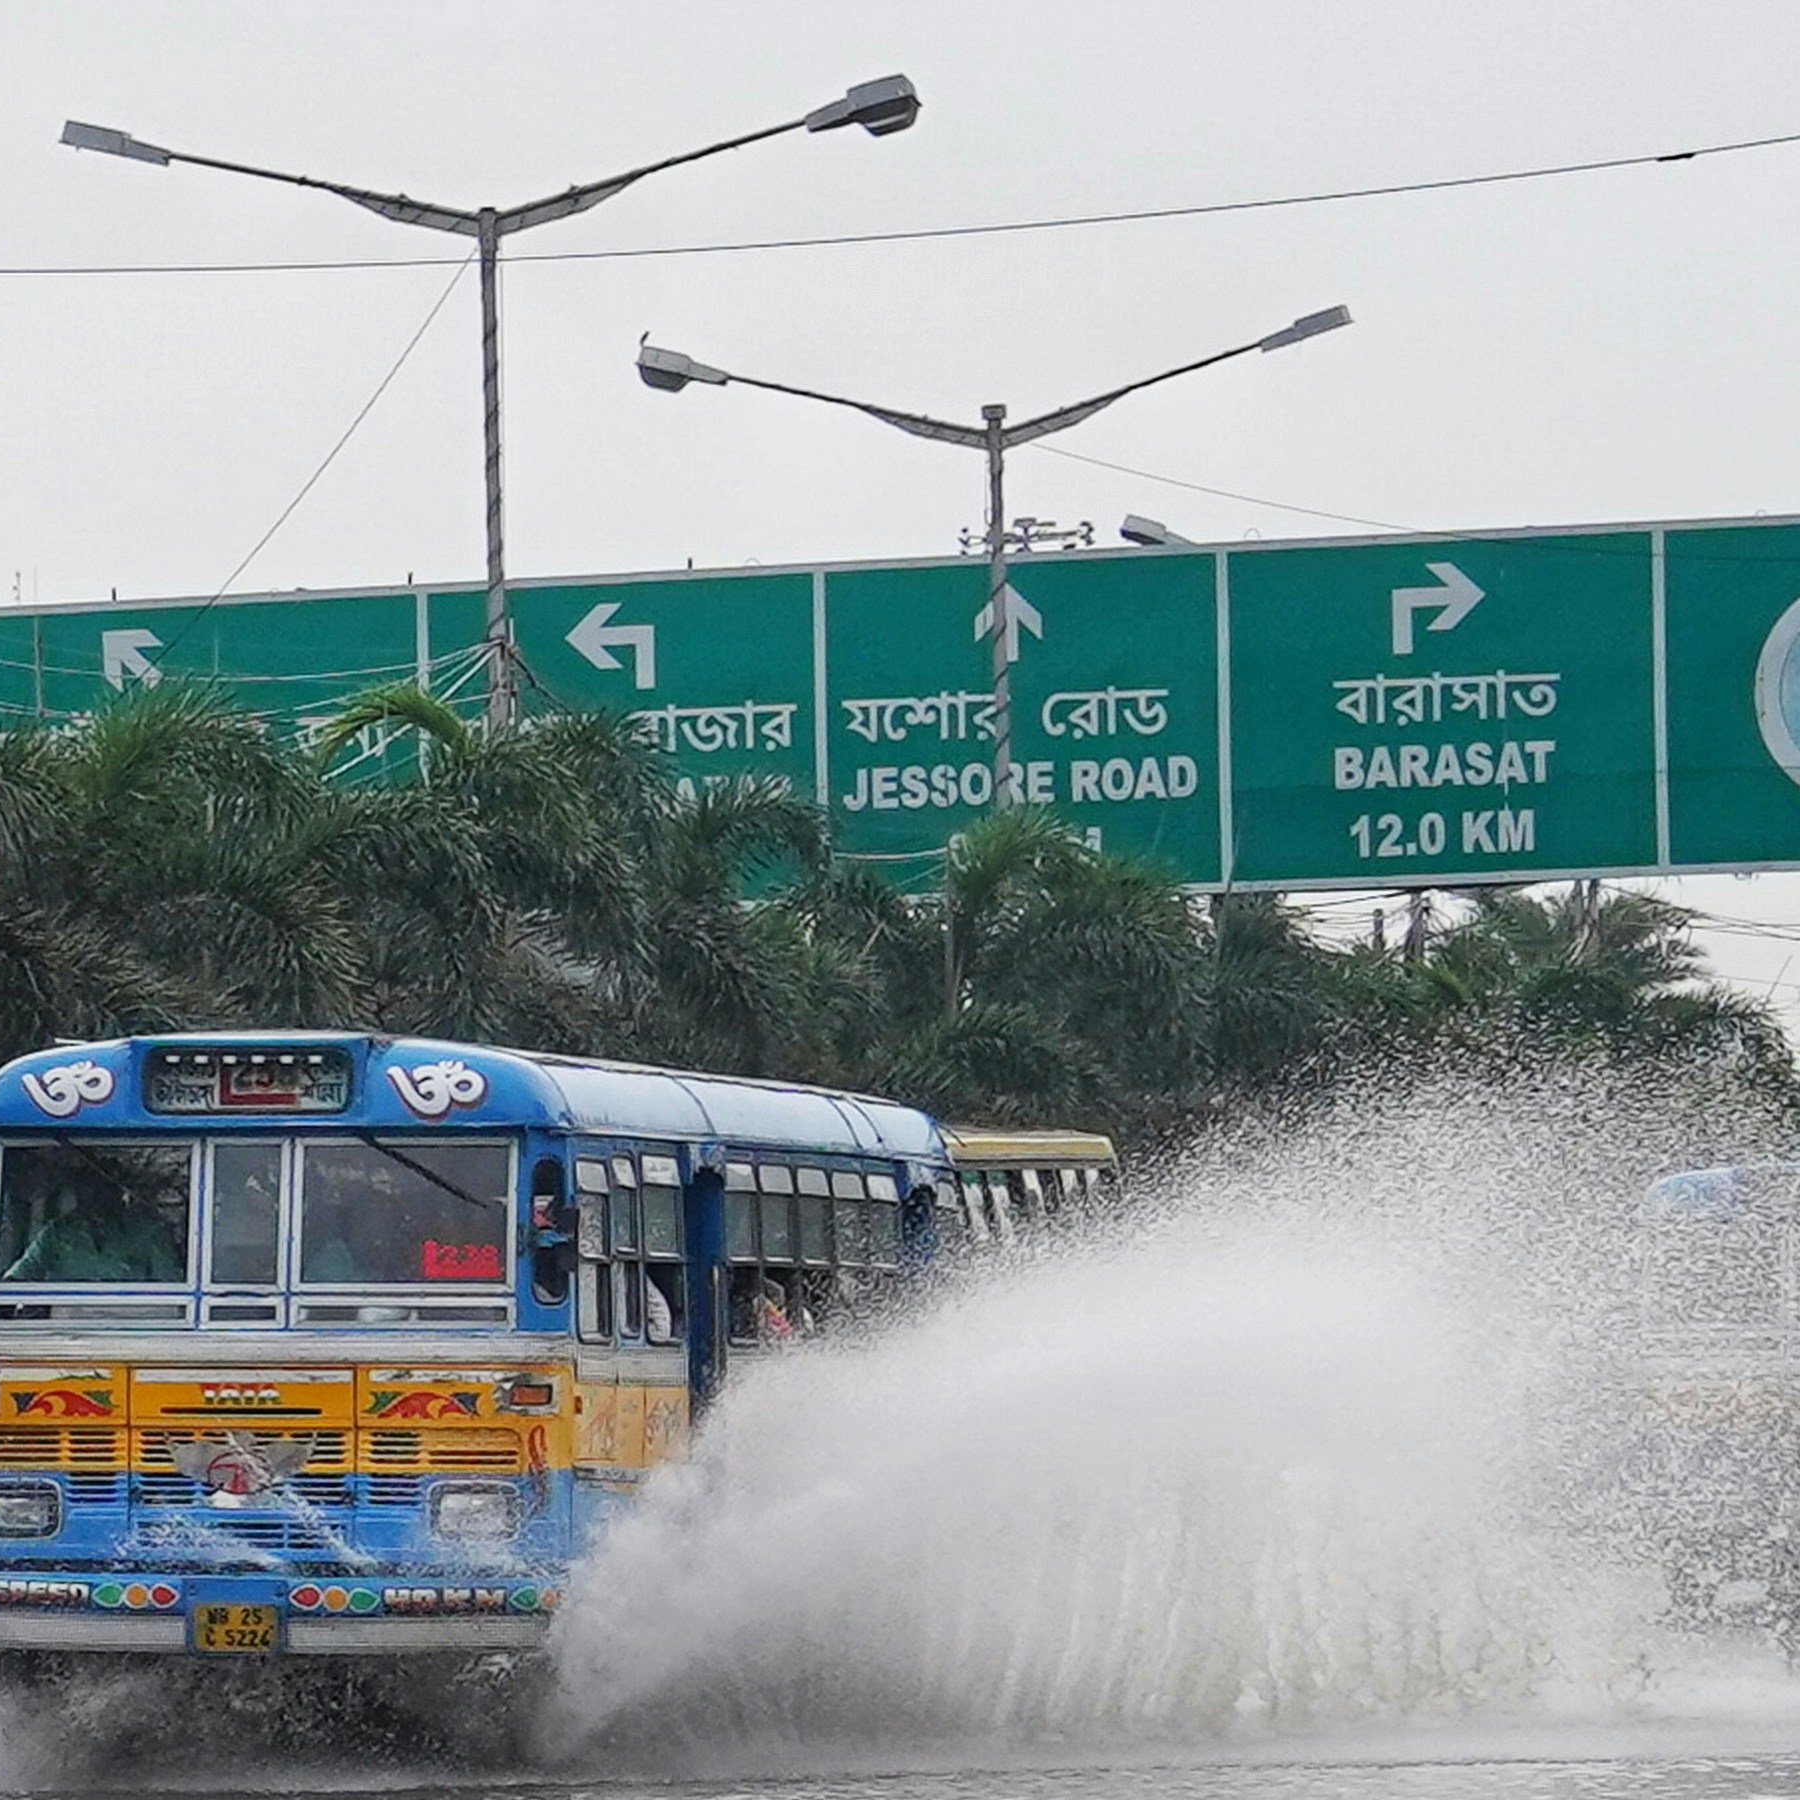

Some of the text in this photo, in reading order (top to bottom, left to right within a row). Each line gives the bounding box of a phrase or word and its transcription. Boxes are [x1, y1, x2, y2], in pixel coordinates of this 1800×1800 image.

[1041, 685, 1170, 740] রোড
[1333, 669, 1561, 727] বারাসাত
[843, 760, 1055, 811] JESSORE
[1071, 755, 1199, 803] ROAD
[1333, 740, 1556, 790] BARASAT
[1349, 808, 1536, 858] 12.0 KM
[240, 1607, 263, 1625] 25
